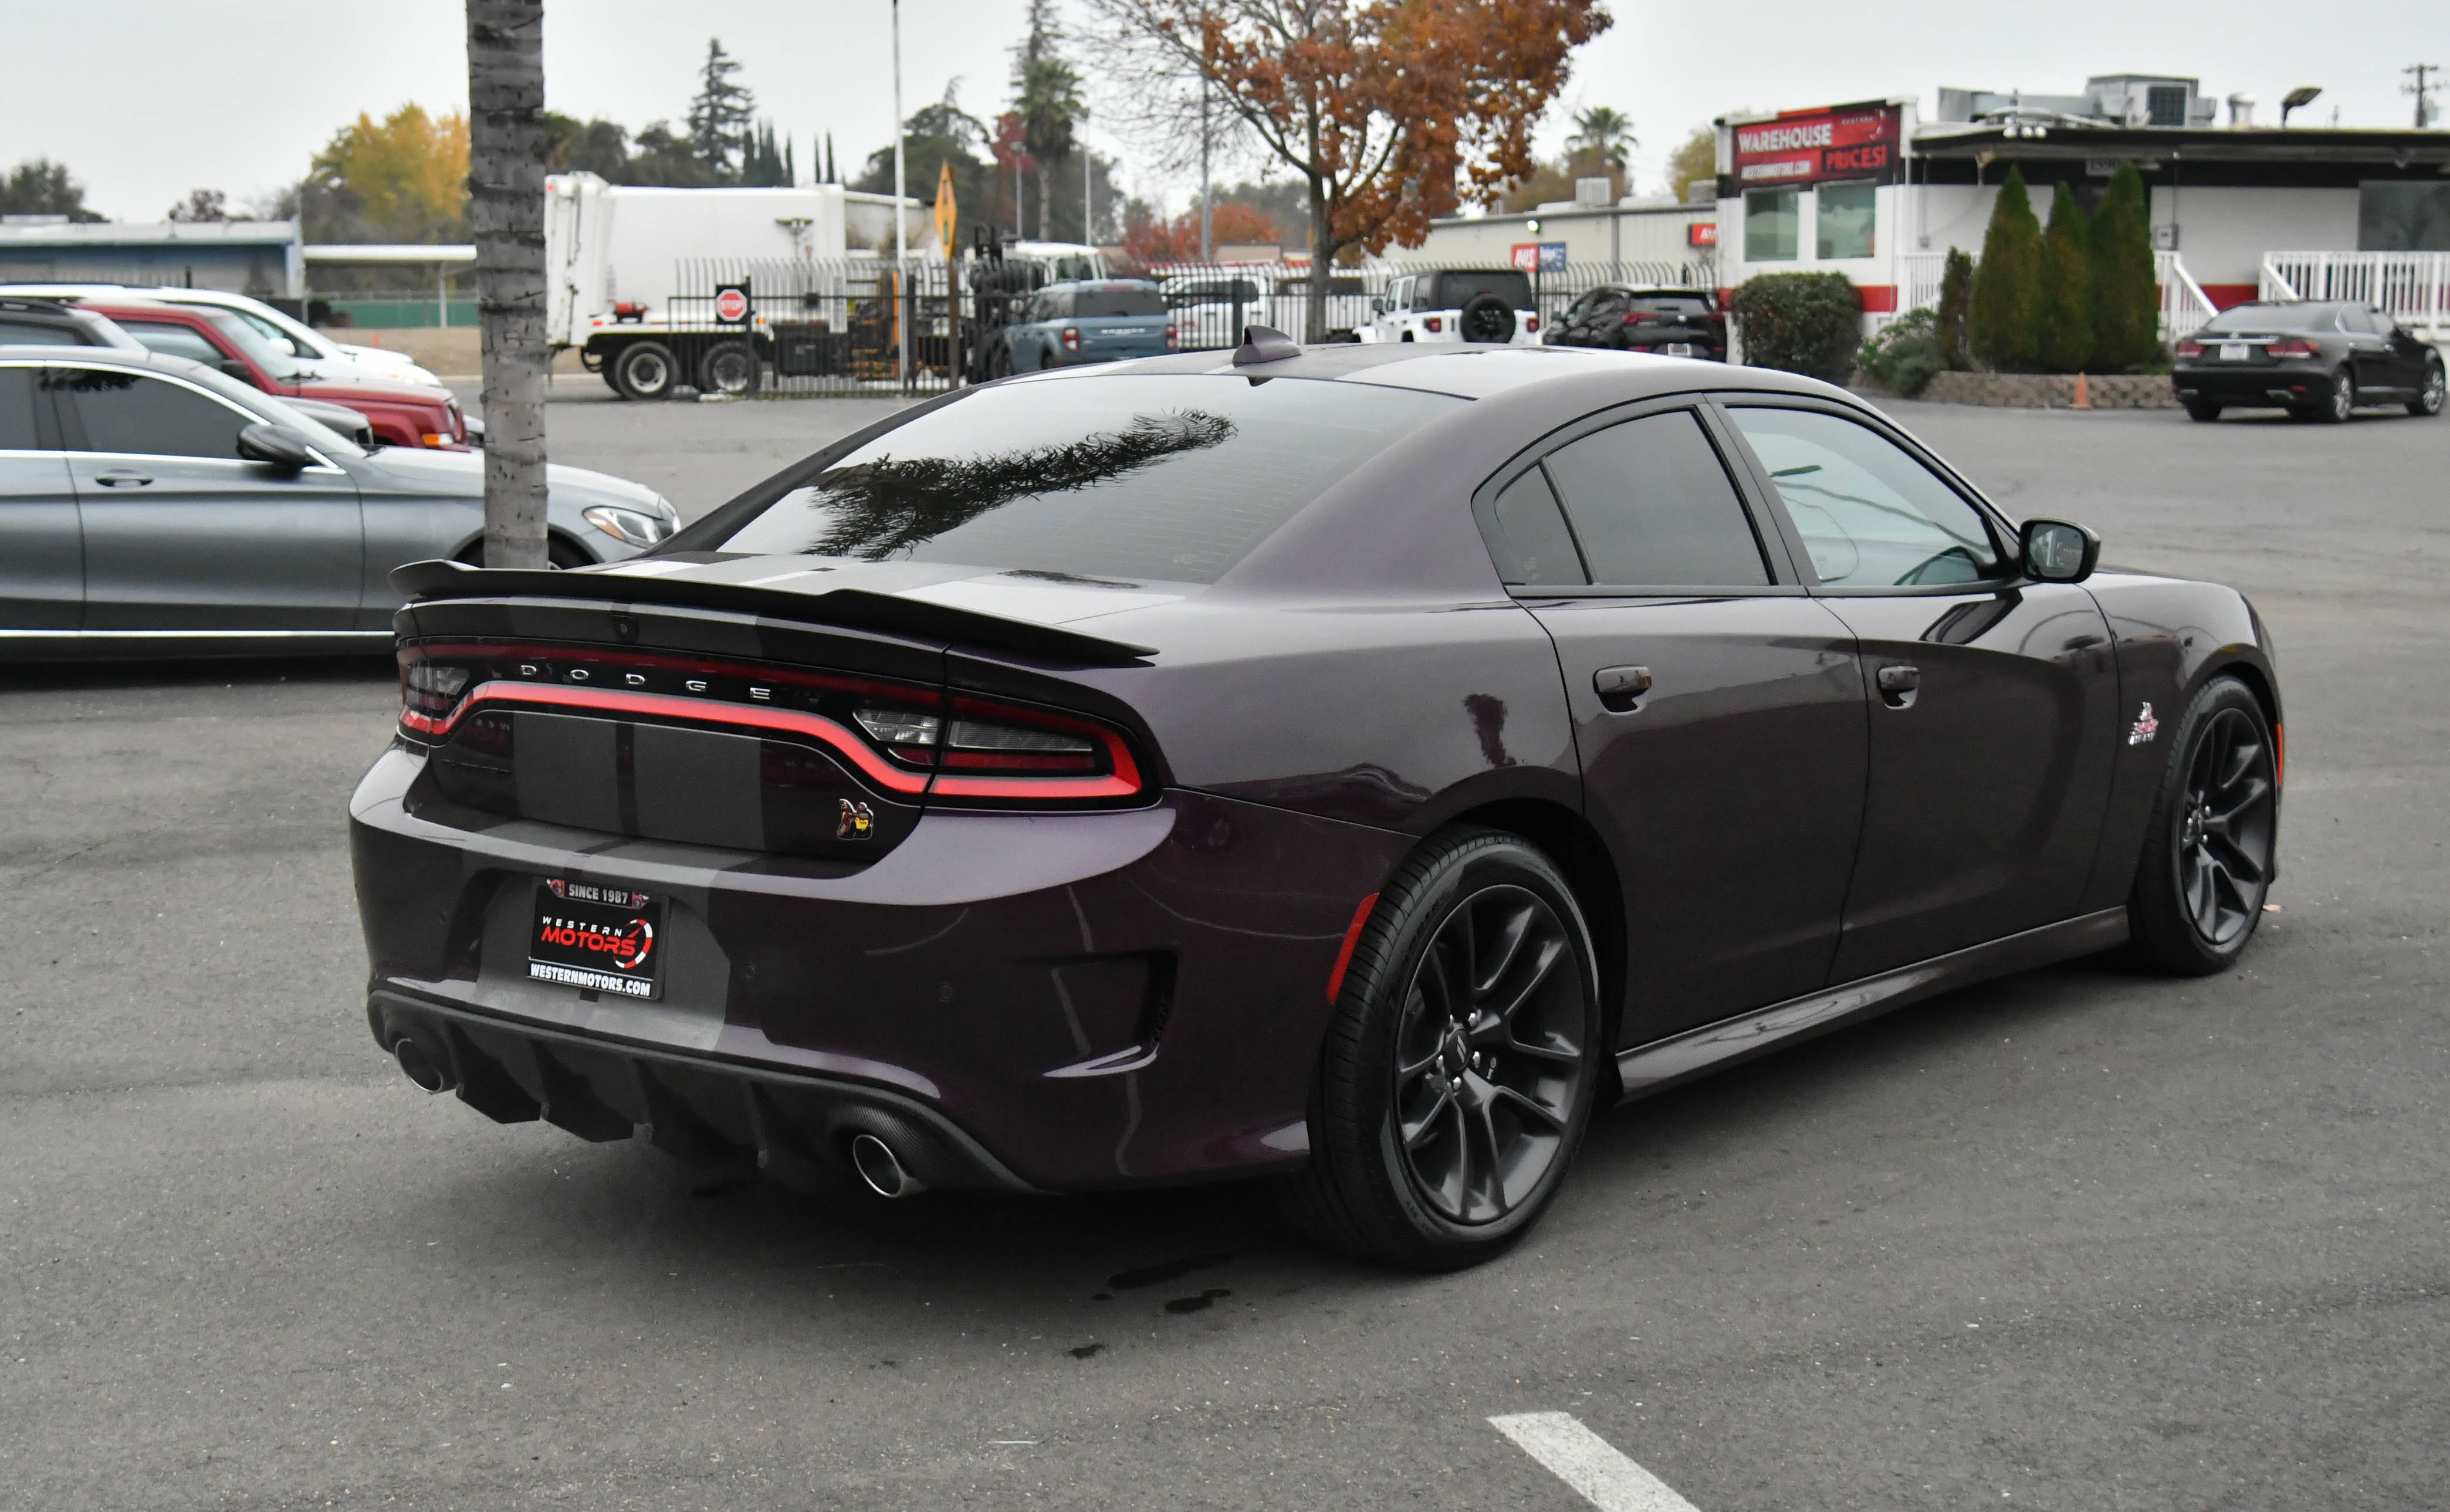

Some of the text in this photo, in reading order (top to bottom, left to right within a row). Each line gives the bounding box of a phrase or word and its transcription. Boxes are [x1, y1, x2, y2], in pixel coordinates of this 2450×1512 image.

[1738, 123, 1832, 153] WAREHOUSE
[1826, 144, 1887, 170] PRICES!
[721, 299, 743, 310] STOP
[520, 664, 771, 701] DODGE
[568, 884, 628, 904] SINCE 1987
[543, 916, 622, 936] WESTERN
[541, 925, 637, 956] MOTORS
[530, 963, 651, 996] WESTERNMOTORS.COM
